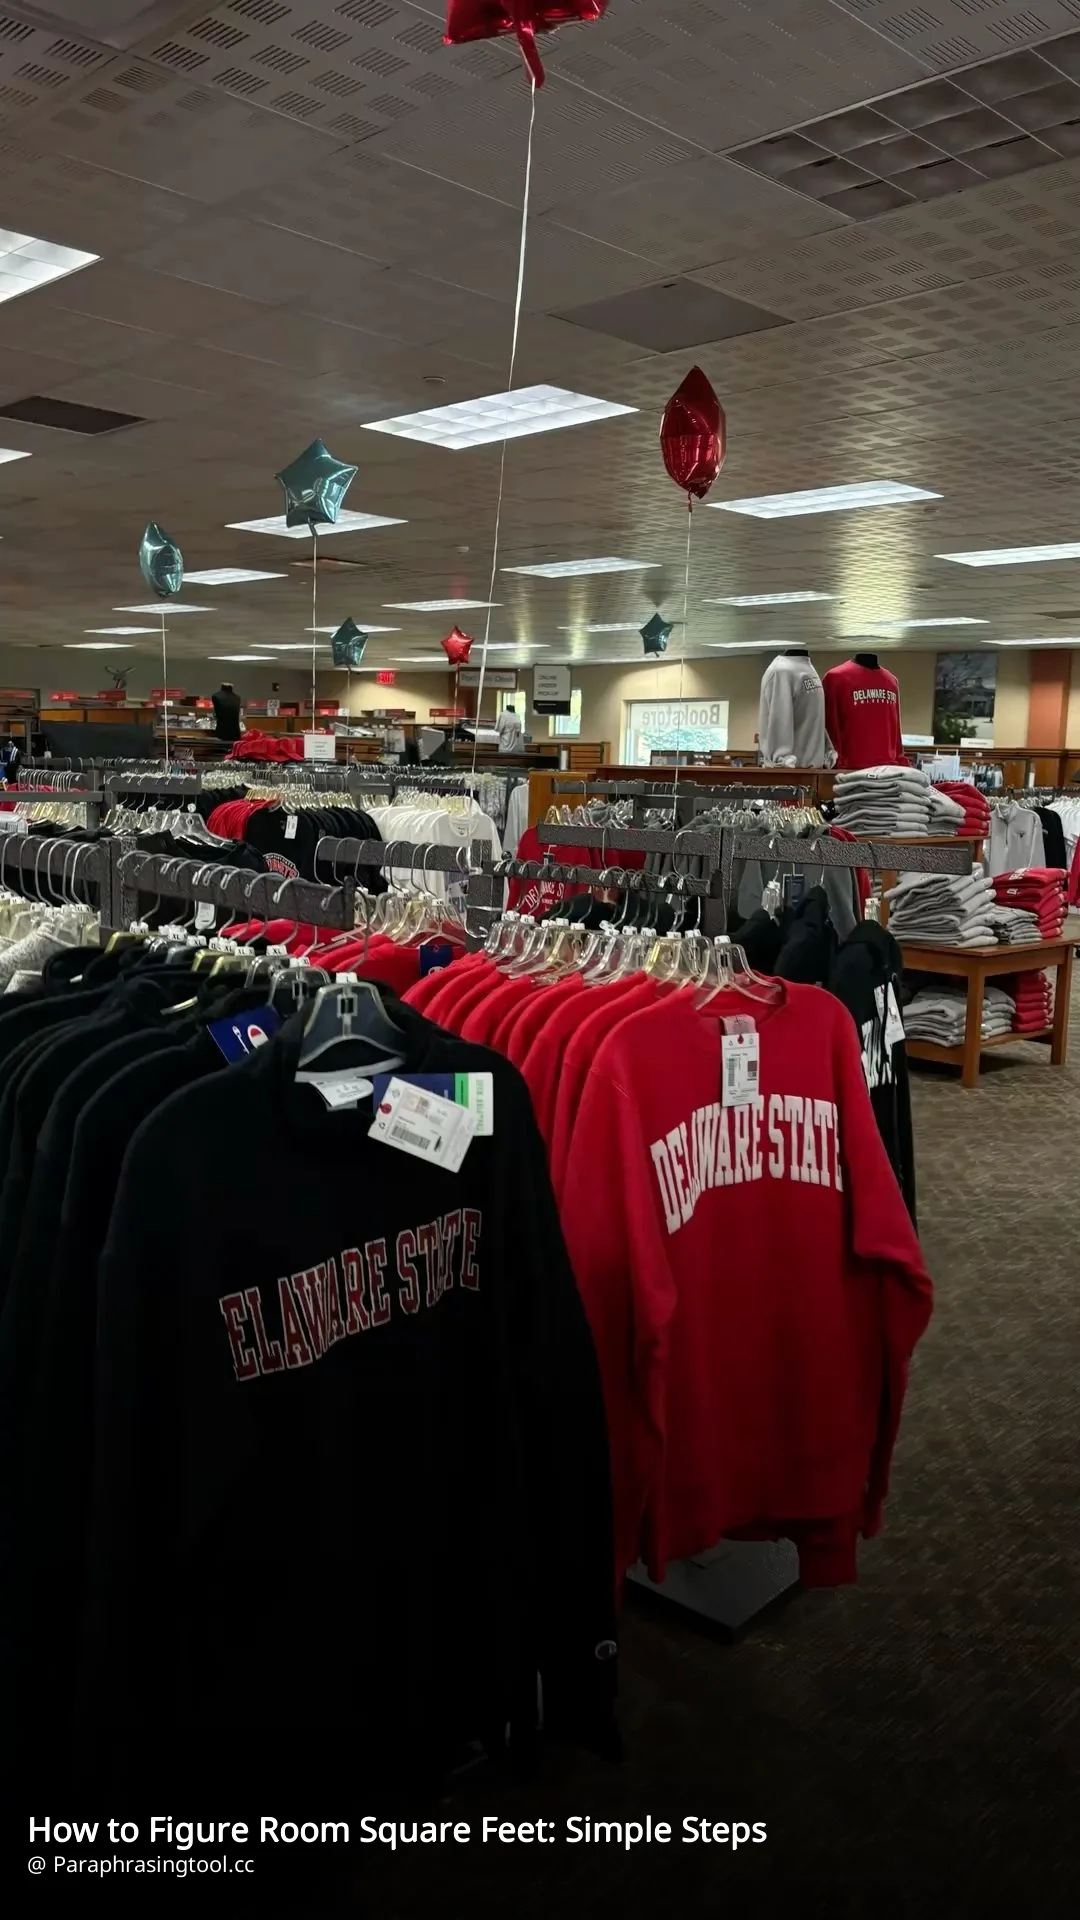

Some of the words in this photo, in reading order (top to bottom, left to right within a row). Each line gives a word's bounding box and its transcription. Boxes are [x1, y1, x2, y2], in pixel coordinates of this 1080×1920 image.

[853, 688, 886, 700] DELAWARE
[650, 1094, 765, 1235] DELAWARE
[218, 1237, 393, 1382] ELAWARE
